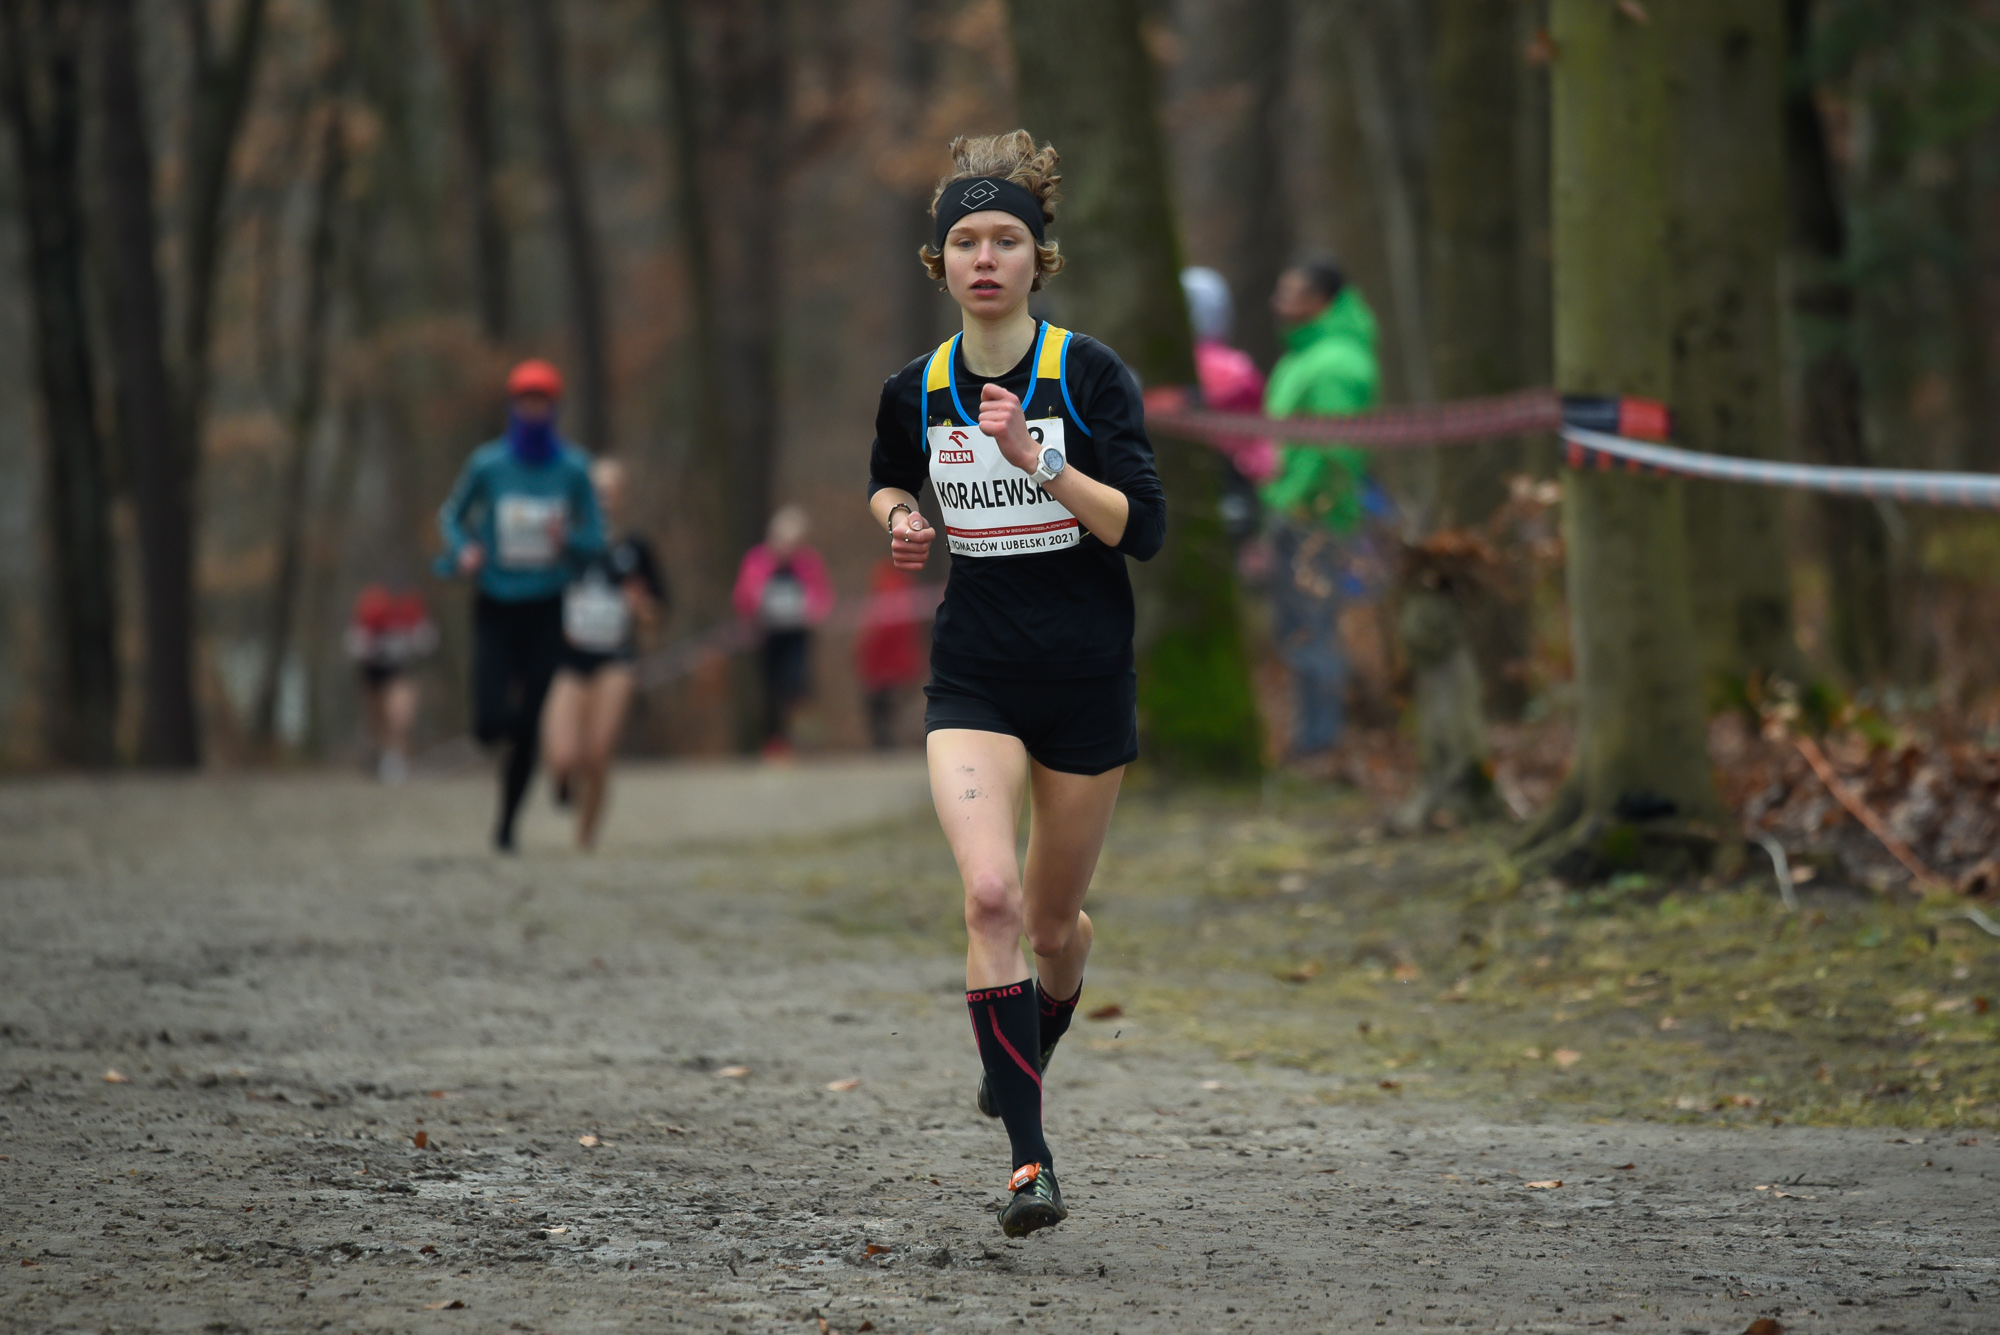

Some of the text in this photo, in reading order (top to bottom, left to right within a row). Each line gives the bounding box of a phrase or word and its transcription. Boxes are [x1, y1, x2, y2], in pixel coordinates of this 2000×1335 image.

[940, 451, 972, 463] ORLEN
[936, 477, 1057, 510] KORALEWSK
[951, 532, 1074, 553] TOMASZÓW LUBELSKI 2021
